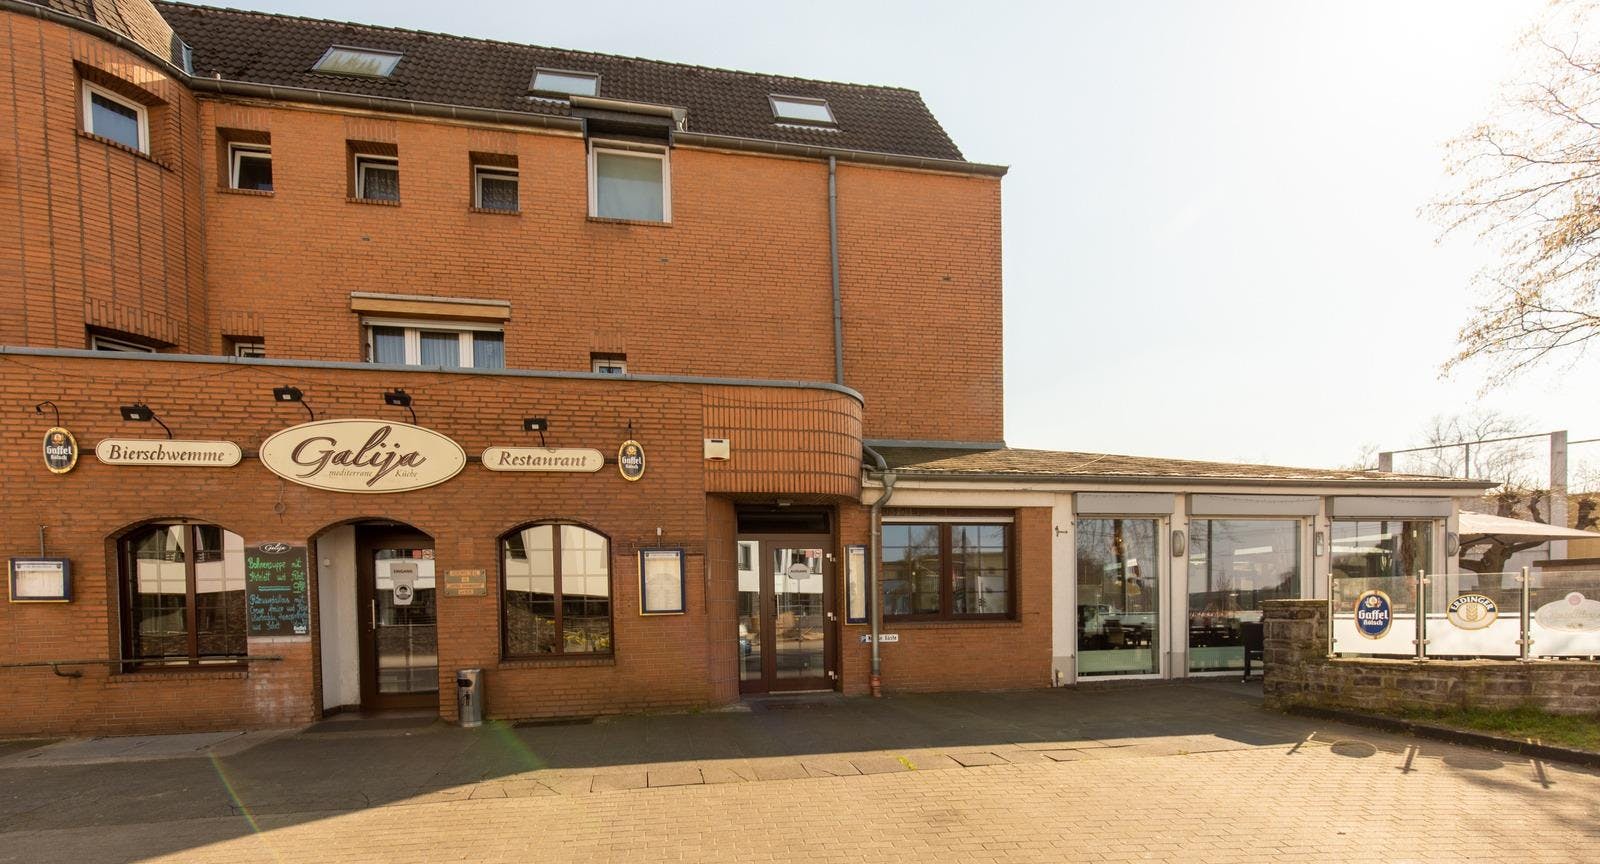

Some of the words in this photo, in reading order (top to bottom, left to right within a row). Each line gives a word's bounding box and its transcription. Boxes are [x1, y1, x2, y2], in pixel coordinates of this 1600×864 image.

[46, 445, 73, 455] Gaffel
[109, 444, 225, 462] Bierschwemme
[291, 425, 427, 487] Galija
[498, 451, 588, 467] Restaurant
[621, 456, 642, 465] Gaffel
[1451, 596, 1494, 610] ERDINGER
[1358, 609, 1389, 620] Gaffel
